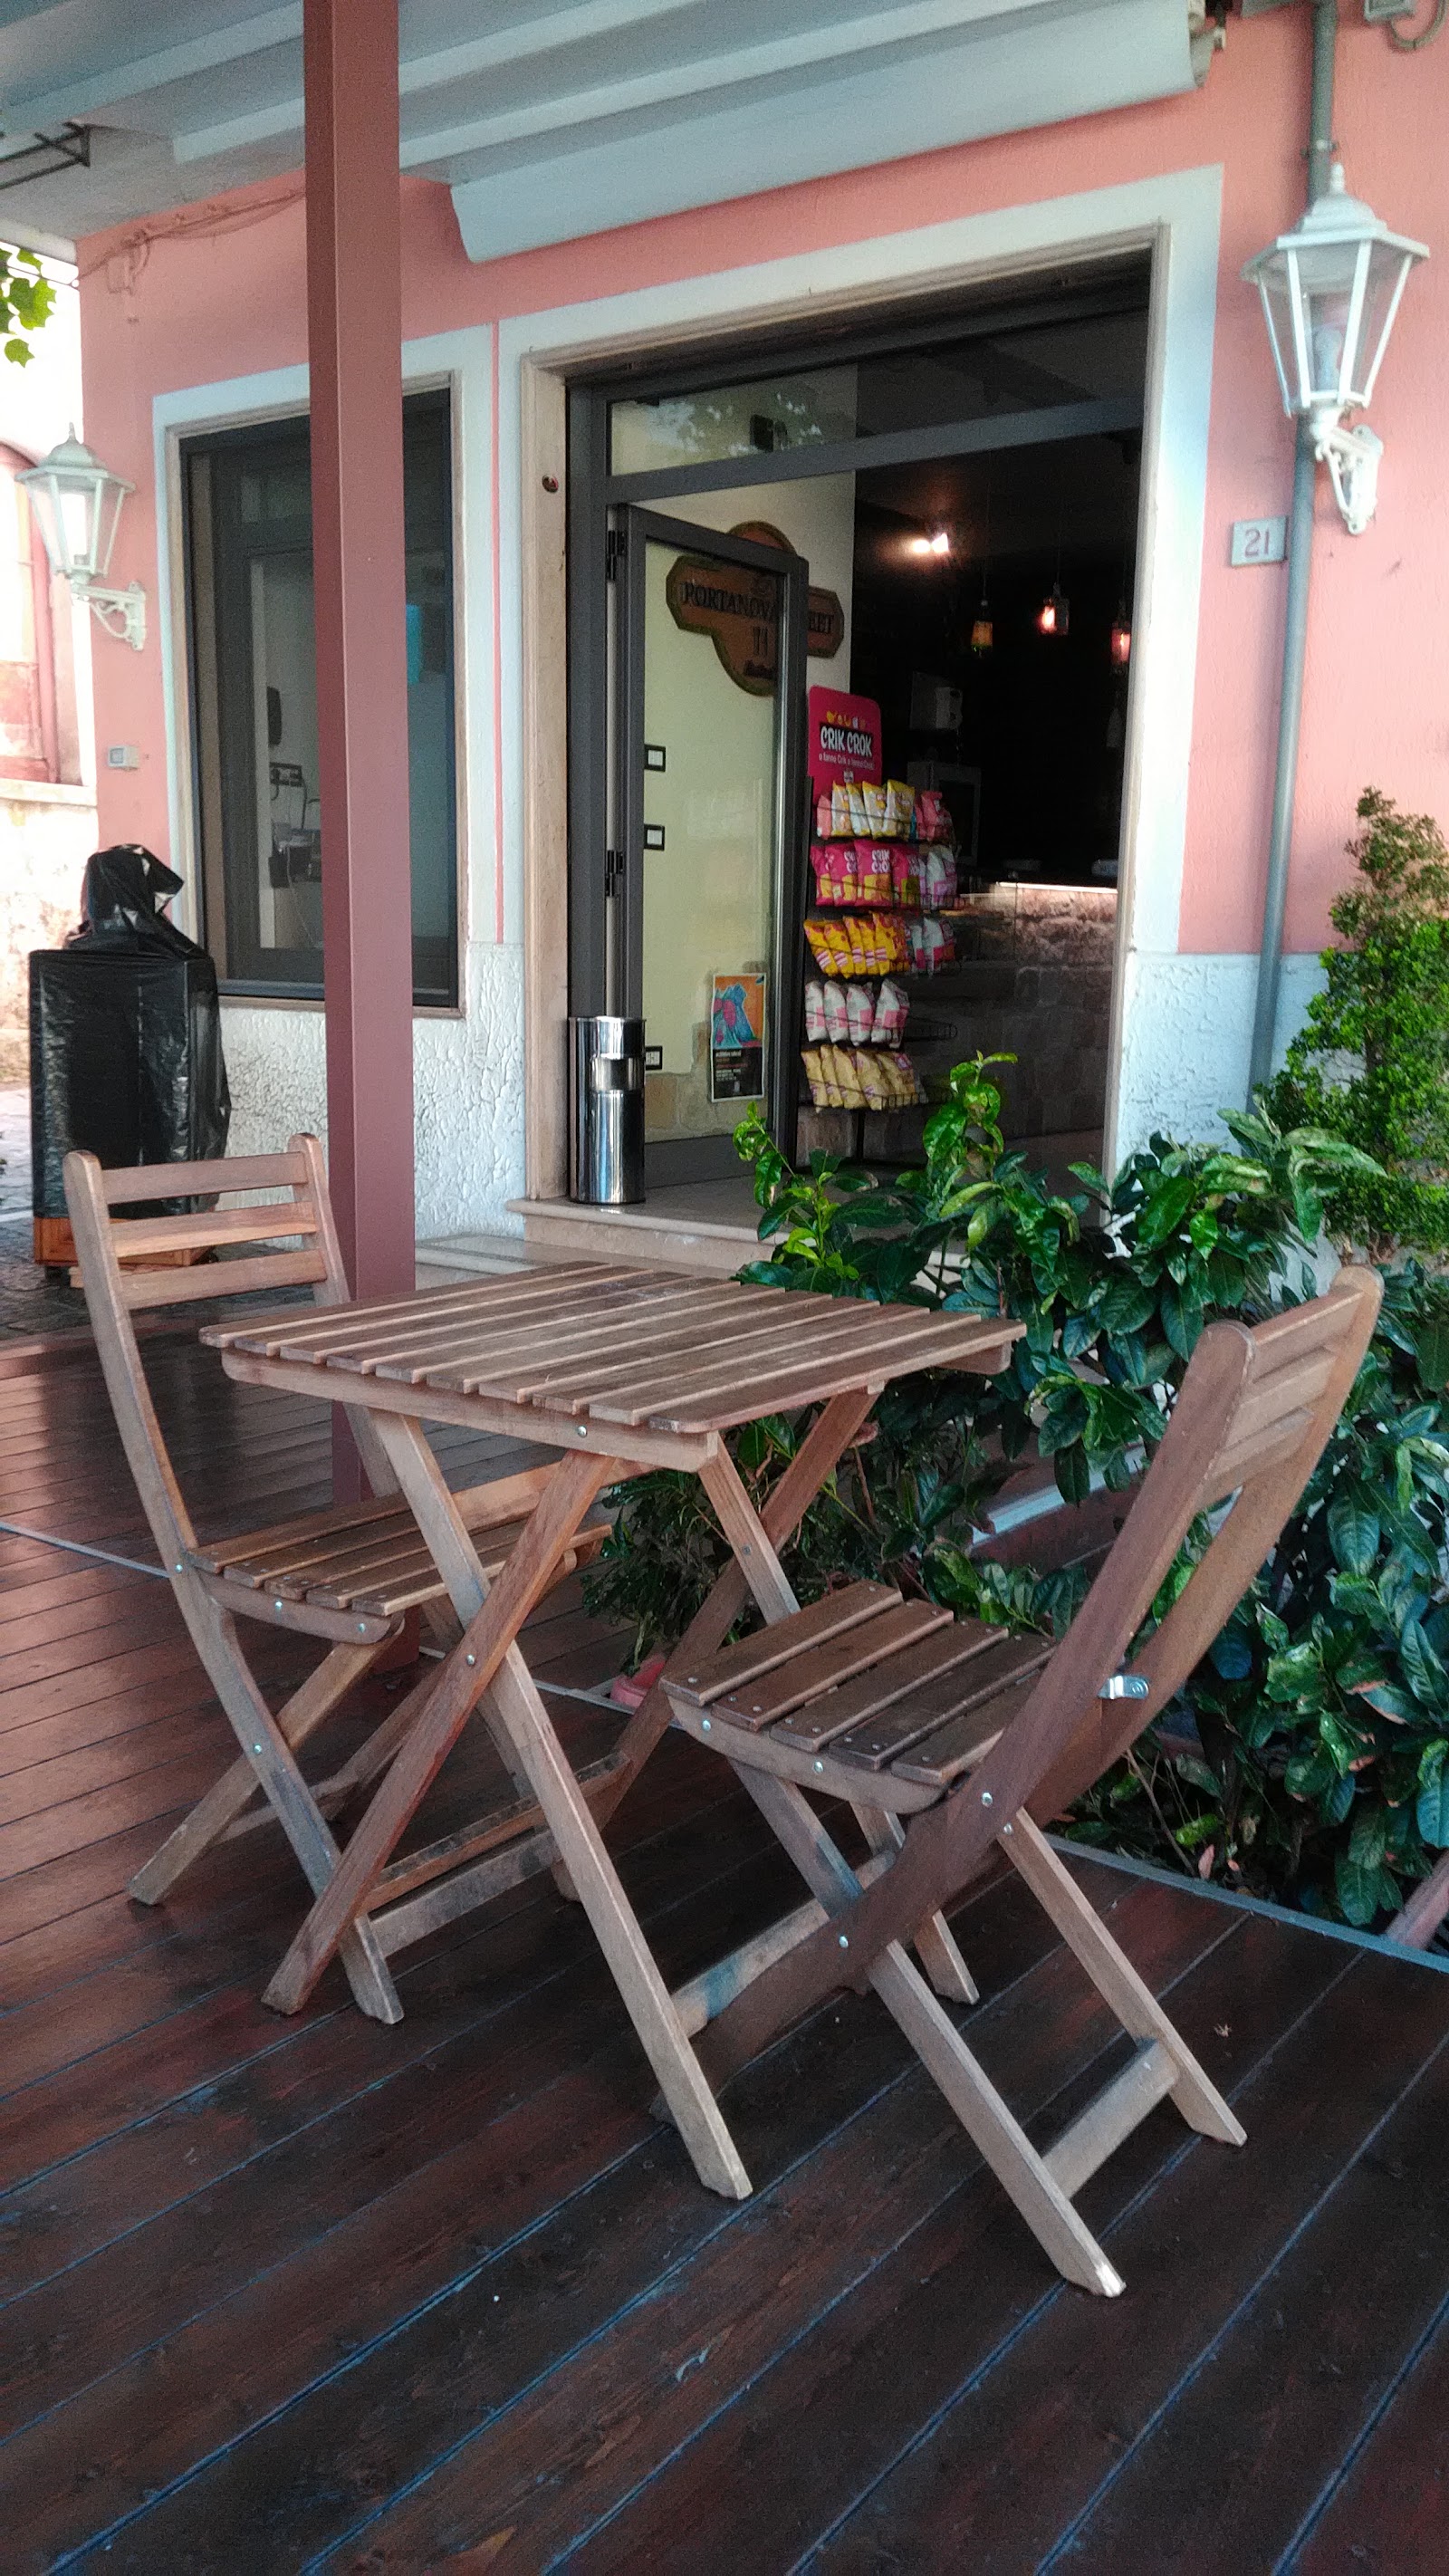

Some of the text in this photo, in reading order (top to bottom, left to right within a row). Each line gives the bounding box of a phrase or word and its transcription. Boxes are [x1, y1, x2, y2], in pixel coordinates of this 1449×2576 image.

[1244, 528, 1270, 558] 21
[682, 582, 774, 620] PORTANOV
[820, 726, 872, 757] CRIK CROK
[871, 861, 890, 873] CRO
